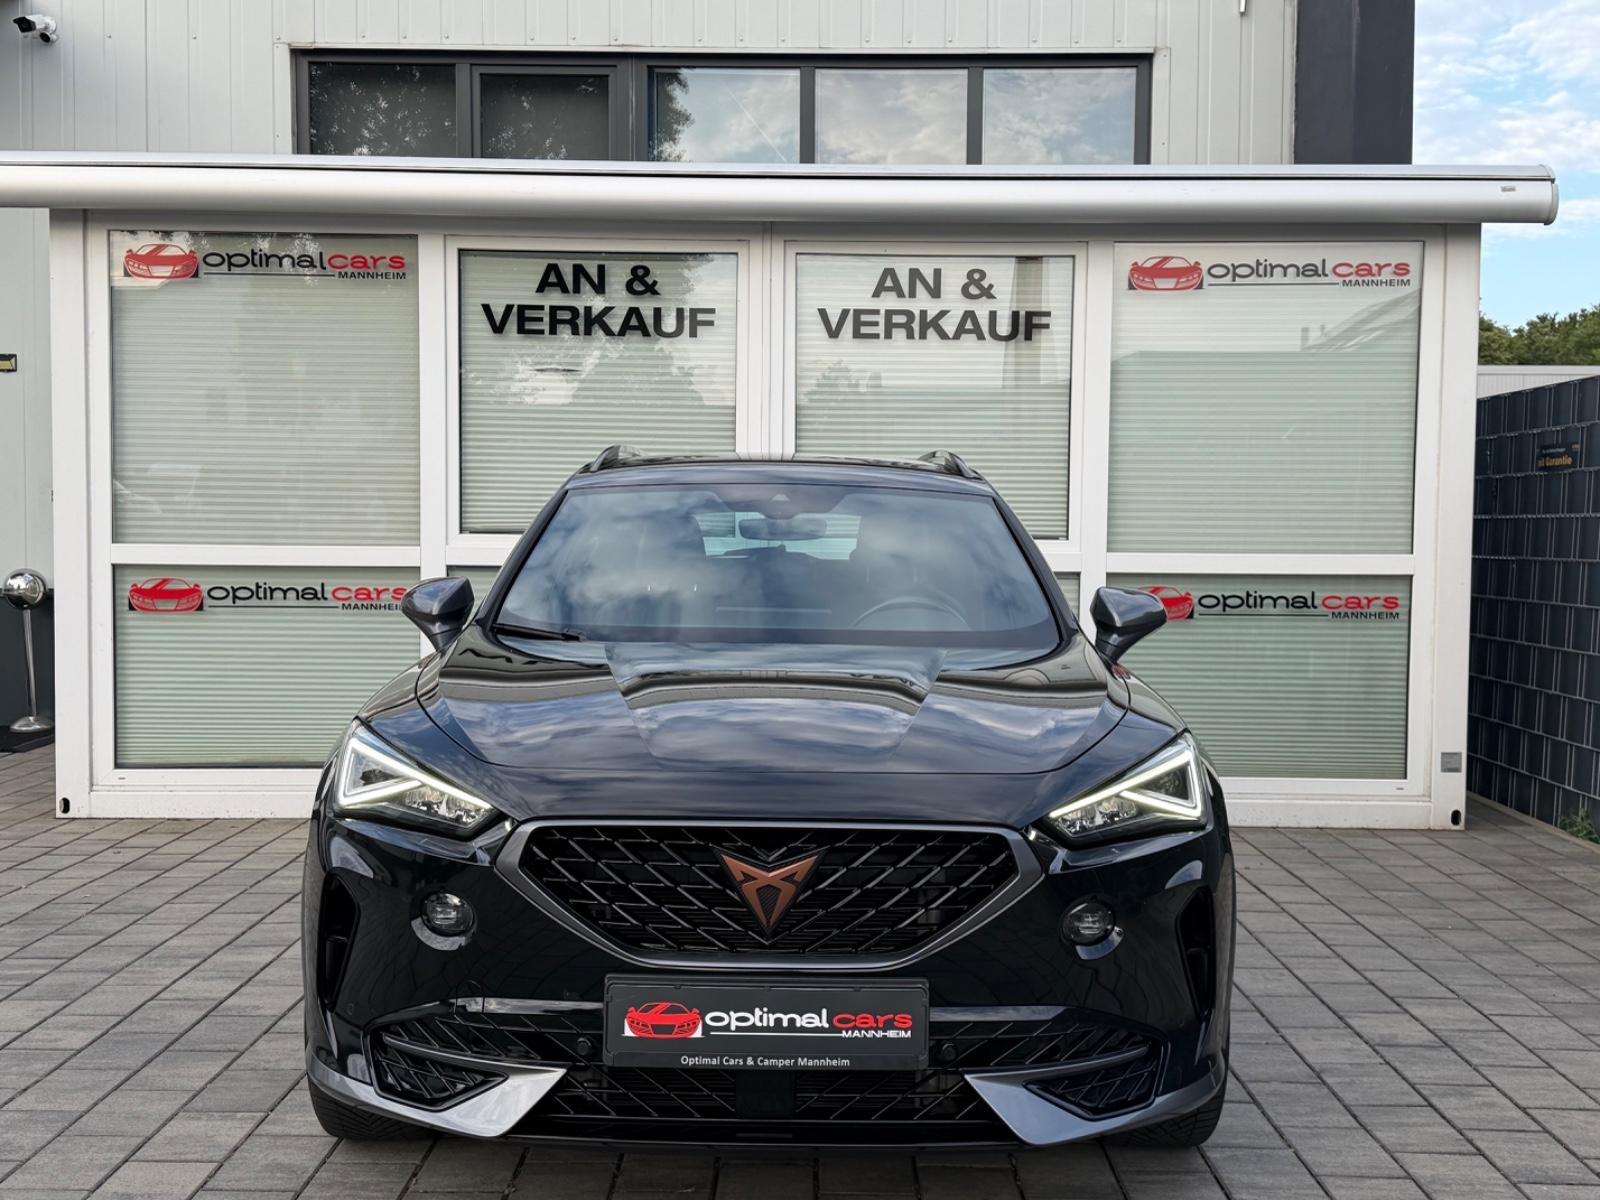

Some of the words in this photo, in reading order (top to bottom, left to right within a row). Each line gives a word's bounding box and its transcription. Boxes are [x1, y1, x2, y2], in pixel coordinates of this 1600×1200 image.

[202, 249, 327, 272] optimal
[328, 254, 406, 270] cars
[1207, 258, 1329, 282] optimal
[1332, 262, 1411, 278] cars
[338, 271, 406, 280] MANNHEIM
[535, 263, 606, 295] AN
[625, 264, 661, 296] &
[871, 267, 942, 299] AN
[960, 268, 997, 300] &
[1342, 279, 1411, 288] MANNHEIM
[481, 303, 717, 339] VERKAUF
[817, 308, 1052, 342] VERKAUF
[206, 582, 328, 604] optimal
[331, 586, 408, 601] cars
[1198, 591, 1319, 612] optimal
[1321, 595, 1400, 610] cars
[341, 603, 401, 611] MANNHEI
[1331, 611, 1400, 620] MANNHEIM
[704, 1007, 829, 1031] optimal
[832, 1013, 913, 1028] cars
[841, 1030, 912, 1039] MANNHEIM
[680, 1055, 720, 1067] Optimal
[722, 1056, 745, 1066] Cars
[746, 1056, 755, 1066] &
[757, 1056, 796, 1069] Camper
[797, 1056, 851, 1067] Mannheim
